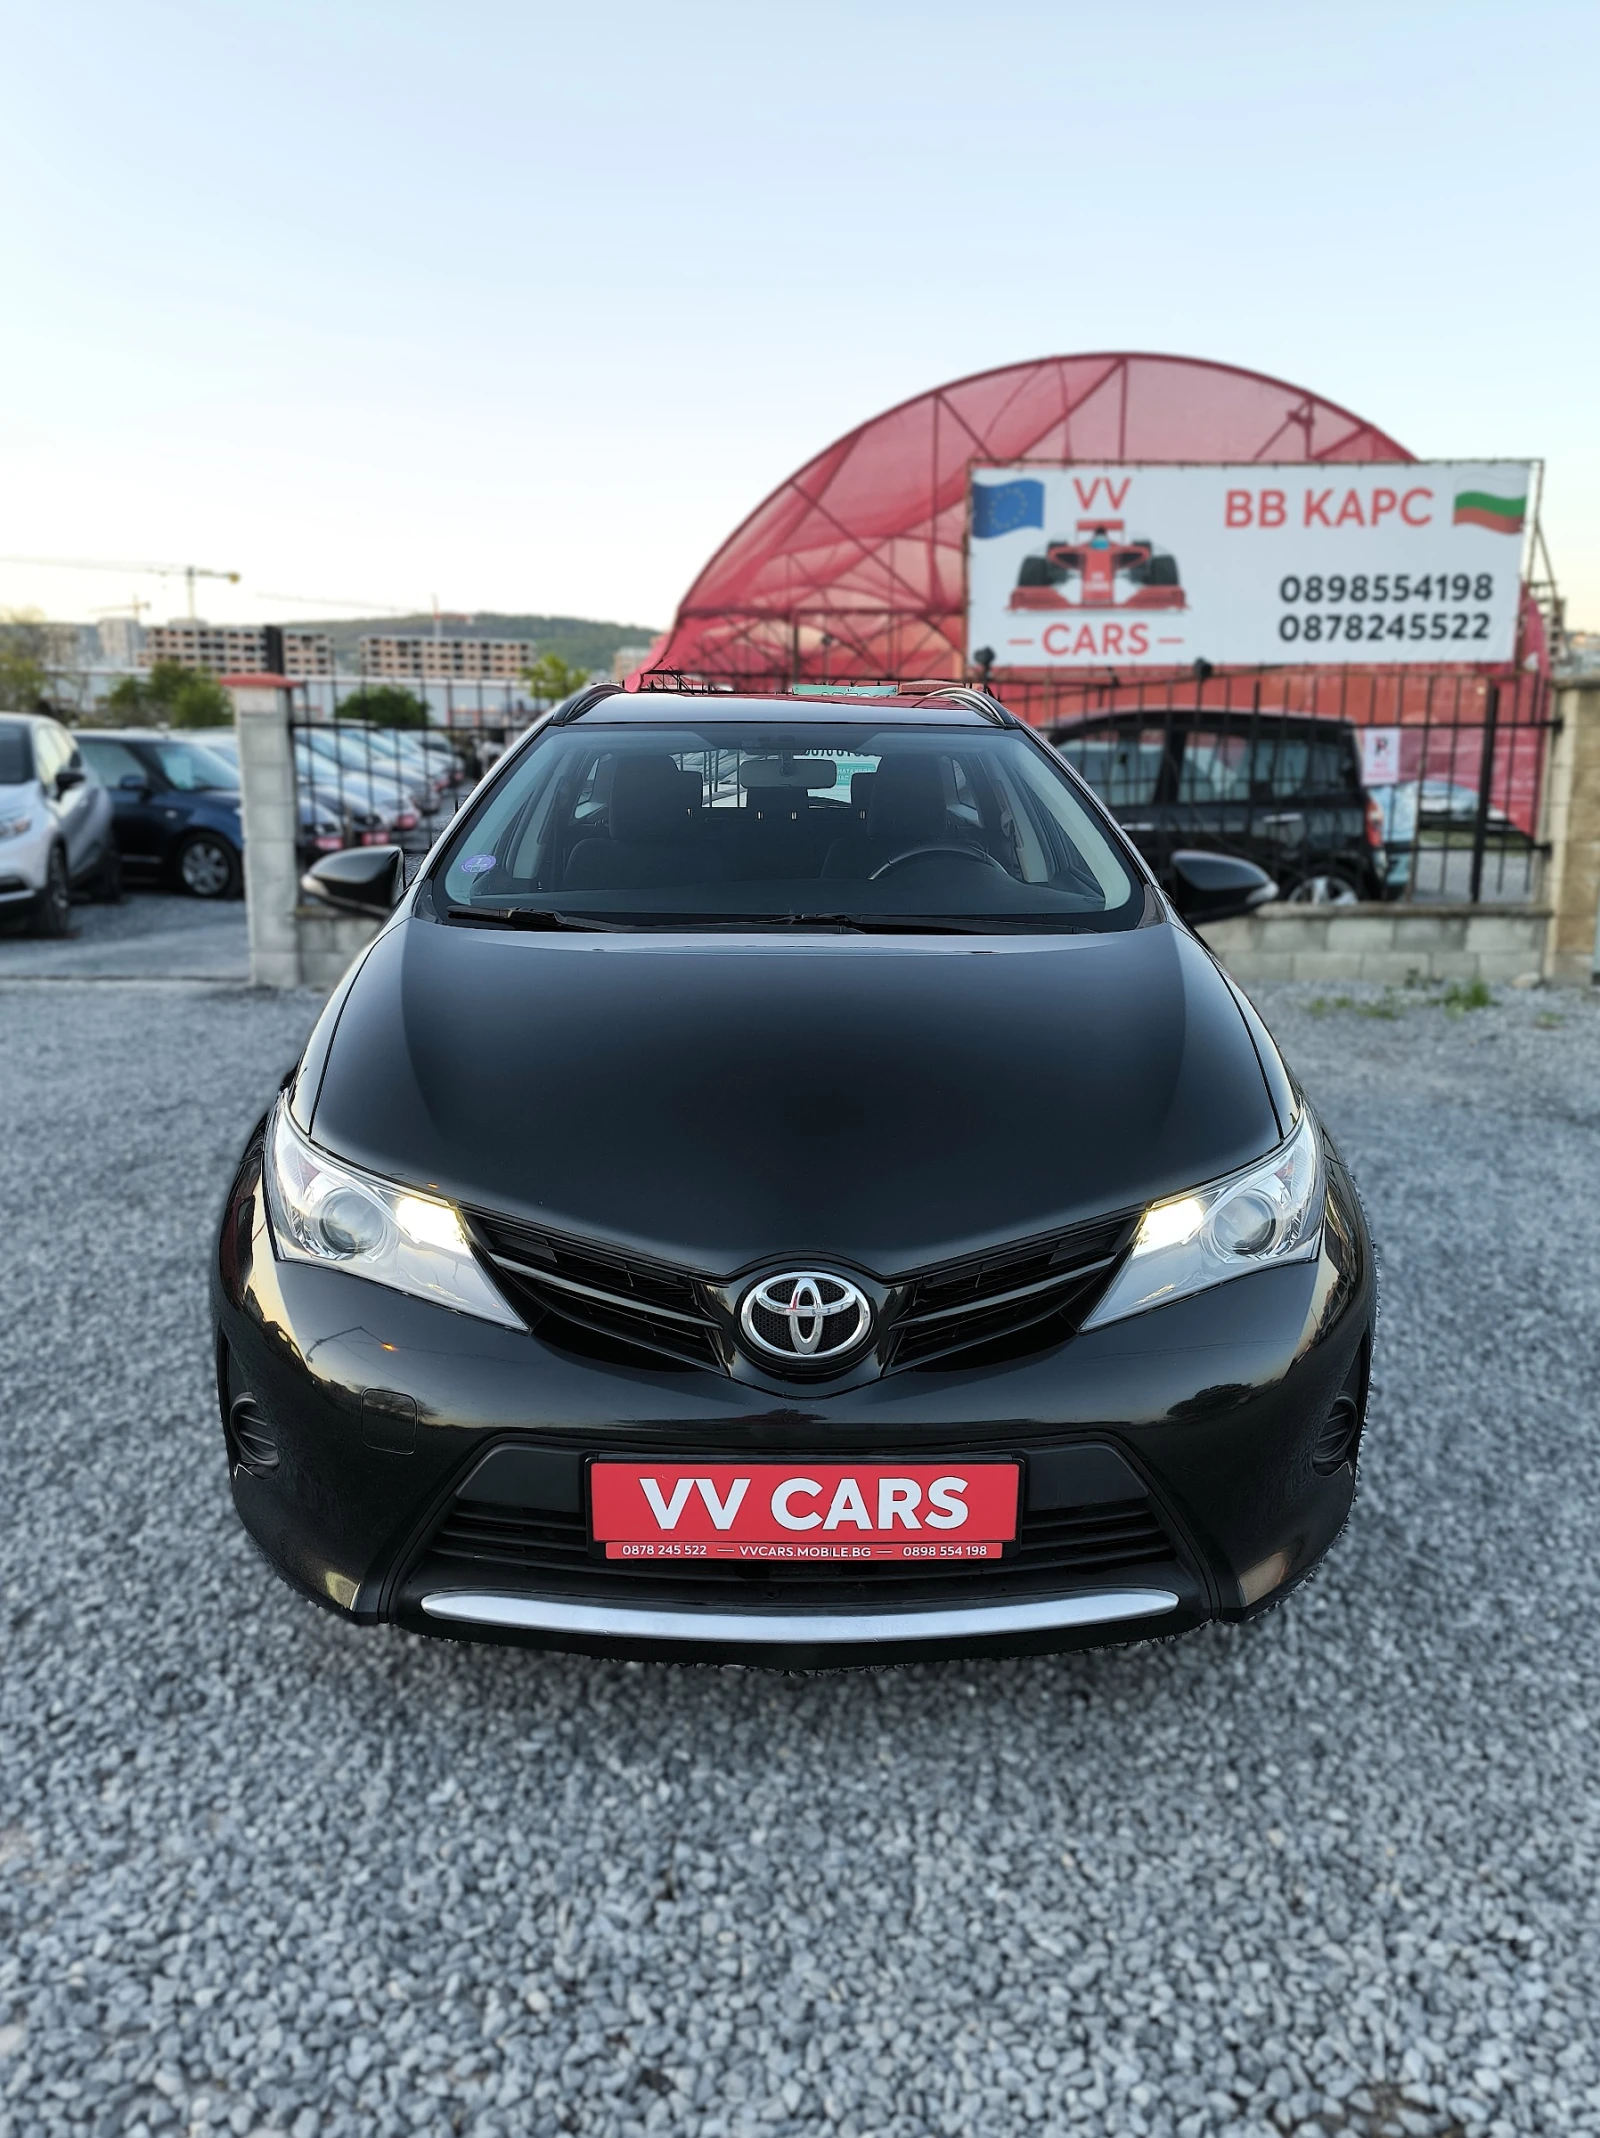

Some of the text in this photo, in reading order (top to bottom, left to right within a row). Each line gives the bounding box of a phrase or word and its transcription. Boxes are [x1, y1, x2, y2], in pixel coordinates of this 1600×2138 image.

[1074, 478, 1130, 510] VV
[1303, 487, 1434, 528] КАРС
[1279, 572, 1494, 603] 0898554198
[1041, 622, 1150, 656] CARS
[1278, 612, 1491, 643] 0878245522
[638, 1476, 969, 1531] VV CARS
[622, 1545, 988, 1558] 0878 245 522 VVCARS.MOBILE.BG 0898 554 198
